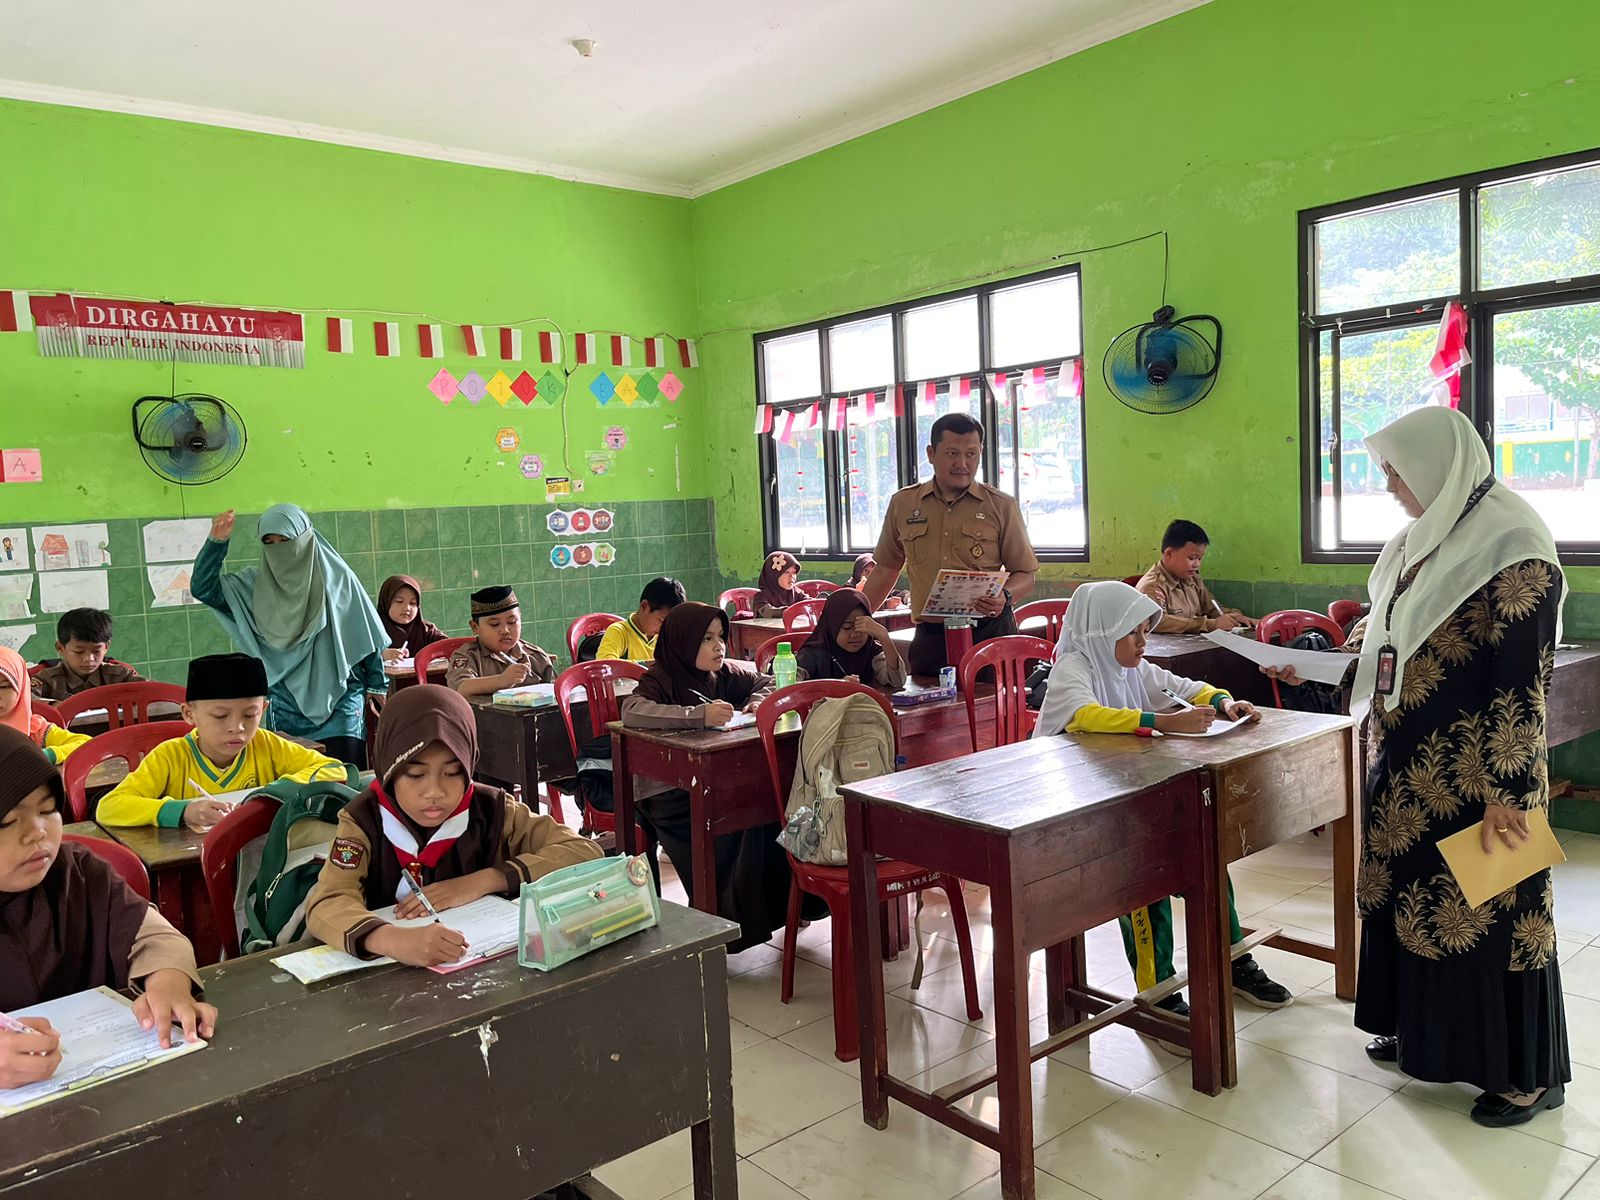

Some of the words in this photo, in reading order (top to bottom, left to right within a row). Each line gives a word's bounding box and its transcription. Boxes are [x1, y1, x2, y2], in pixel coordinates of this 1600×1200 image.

[86, 306, 255, 334] DIRGAHAYU
[175, 340, 260, 355] INDONESIA
[599, 381, 674, 399] BACA
